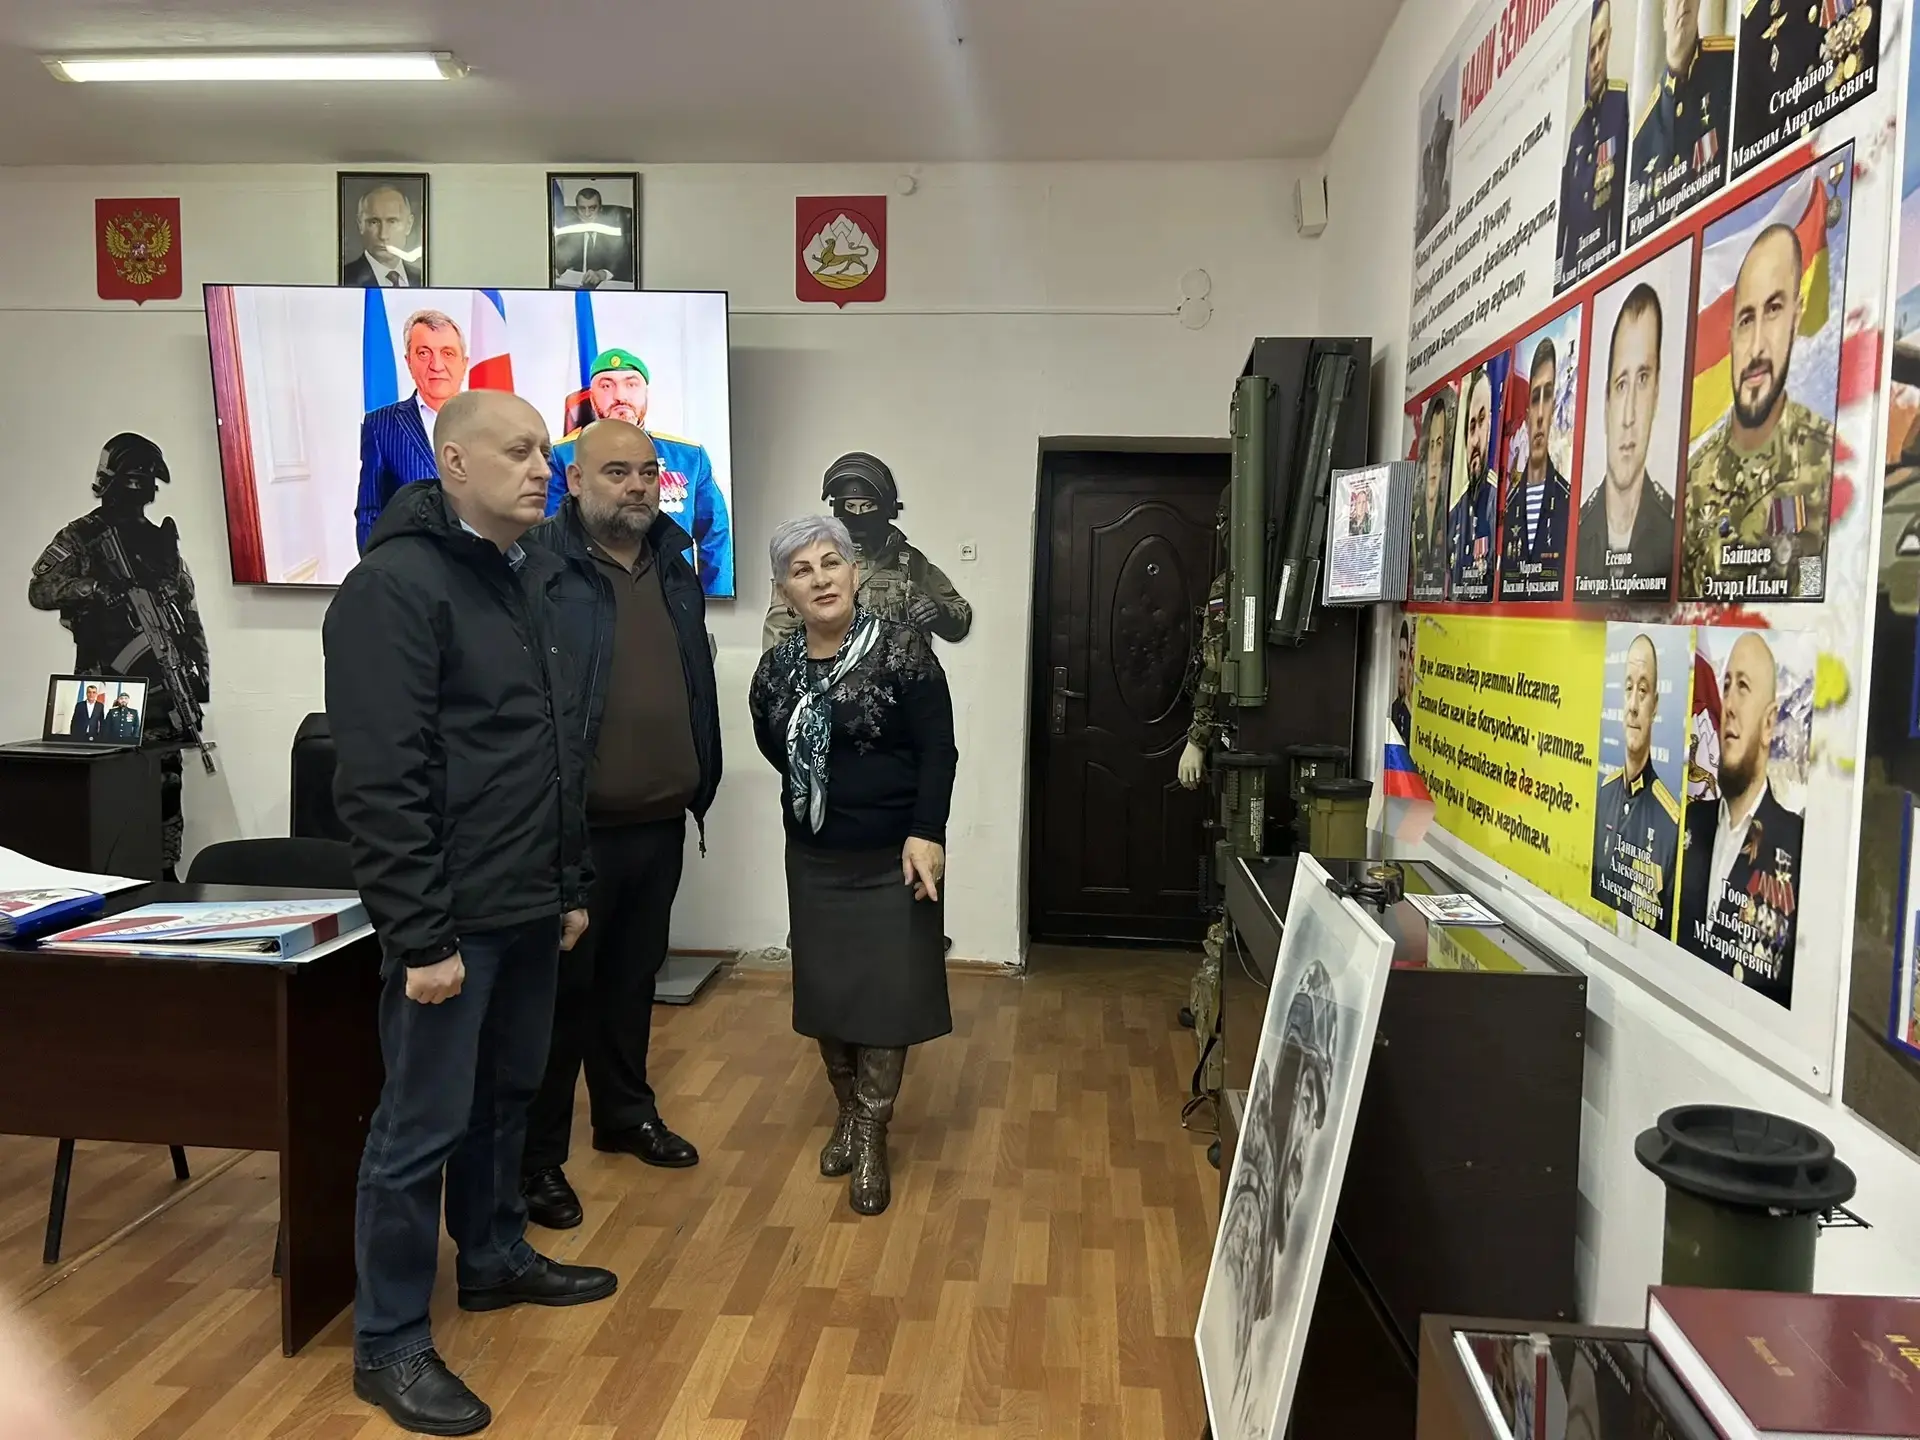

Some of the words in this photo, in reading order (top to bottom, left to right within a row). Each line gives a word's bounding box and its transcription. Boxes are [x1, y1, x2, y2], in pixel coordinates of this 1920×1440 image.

[1459, 21, 1497, 128] НАШИ
[1769, 59, 1834, 114] Стефанов
[1731, 128, 1780, 171] Максим
[1781, 65, 1875, 140] Анатольевич
[1661, 160, 1688, 188] Абаев
[1629, 205, 1655, 236] Юрий
[1656, 164, 1721, 219] Маирбекович
[1605, 550, 1632, 566] Есенов
[1722, 545, 1771, 566] Байцаев
[1575, 576, 1608, 595] Таймураз
[1608, 573, 1667, 595] Ахсарбекович
[1704, 576, 1744, 600] Эдуард
[1746, 574, 1788, 595] Ильич
[1614, 833, 1652, 864] Данилов
[1609, 855, 1654, 894] Александр
[1721, 878, 1748, 909] Гоов
[1599, 873, 1664, 920] Александрович
[1708, 901, 1759, 943] Альберт
[1693, 919, 1772, 979] Мусарбиевич
